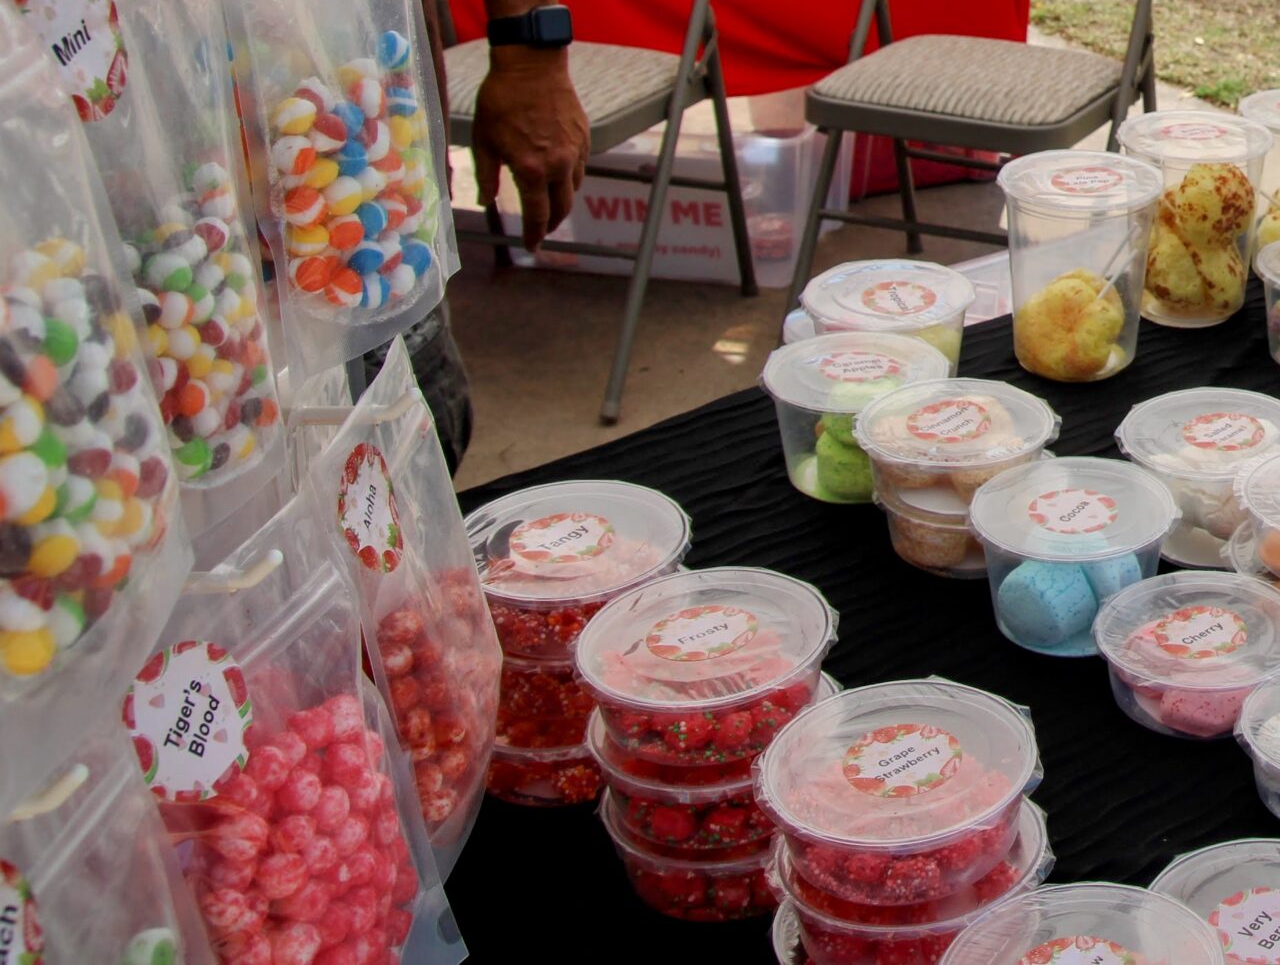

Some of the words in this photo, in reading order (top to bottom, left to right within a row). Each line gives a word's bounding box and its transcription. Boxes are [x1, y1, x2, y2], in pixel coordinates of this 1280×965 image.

[51, 18, 92, 67] Mini
[671, 199, 723, 227] ME
[920, 405, 970, 432] Cinnamon
[940, 417, 974, 436] Crunch
[363, 484, 378, 532] Aloha
[1060, 501, 1091, 522] Cocoa
[537, 523, 589, 551] Tangy
[678, 621, 729, 645] Frosty
[1182, 622, 1224, 645] Cherry
[163, 678, 203, 749] Tiger's
[188, 694, 221, 758] Blood
[874, 746, 941, 783] Strawberry
[878, 745, 916, 768] Grape
[1237, 909, 1274, 939] Very
